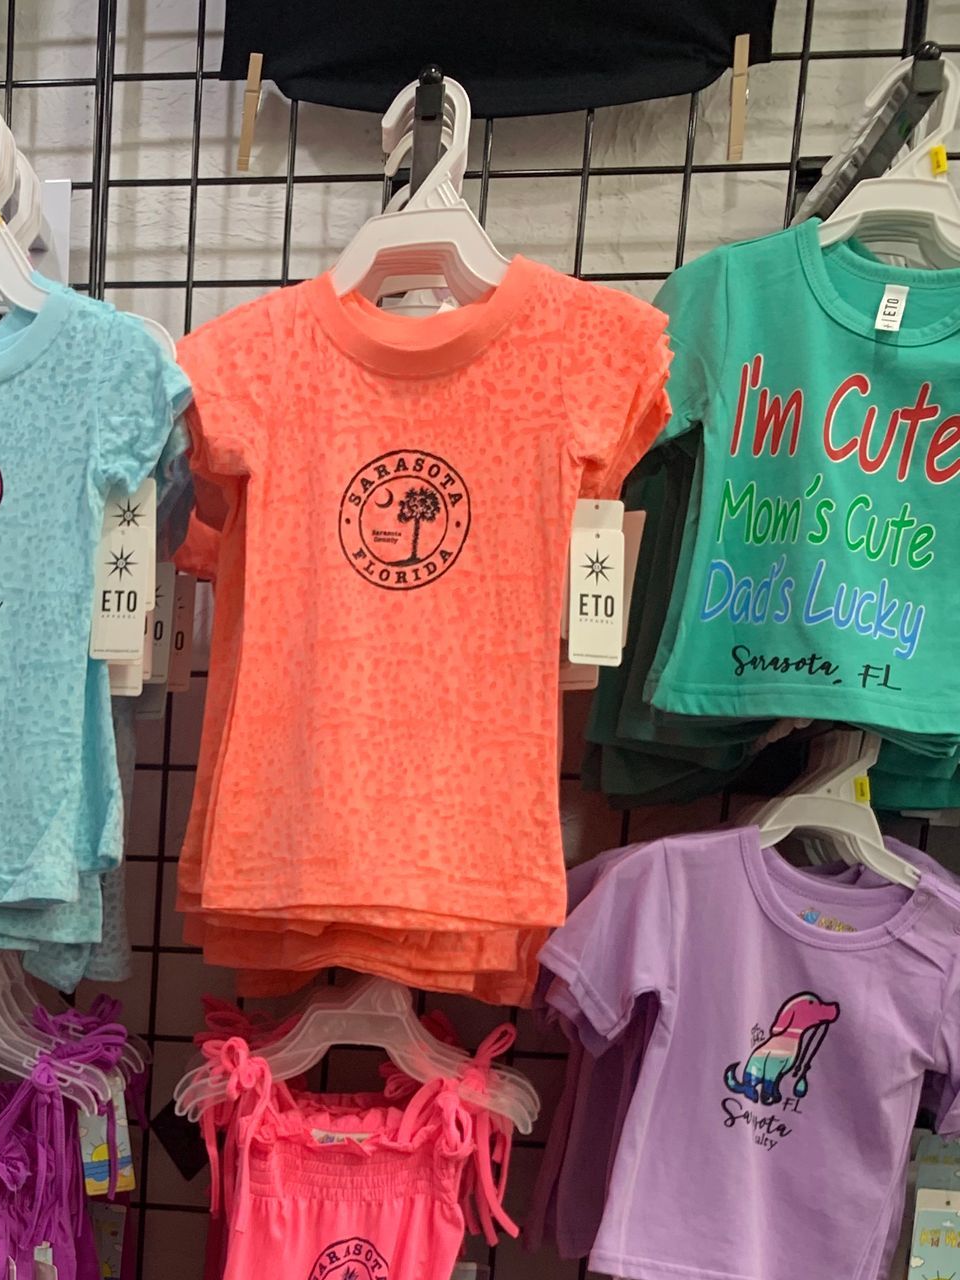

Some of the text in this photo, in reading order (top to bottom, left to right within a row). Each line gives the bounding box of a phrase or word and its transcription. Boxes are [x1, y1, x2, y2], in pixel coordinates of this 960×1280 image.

[883, 298, 900, 317] ETO
[730, 352, 960, 486] I'm Cute
[348, 457, 463, 508] SARASOTA
[716, 473, 936, 570] Mom's Cute
[352, 548, 454, 584] FLORIDA
[101, 590, 138, 613] ETO
[579, 593, 615, 618] ETO
[700, 554, 926, 661] Dad's Lucky
[858, 664, 903, 691] FL
[782, 1097, 803, 1114] FL
